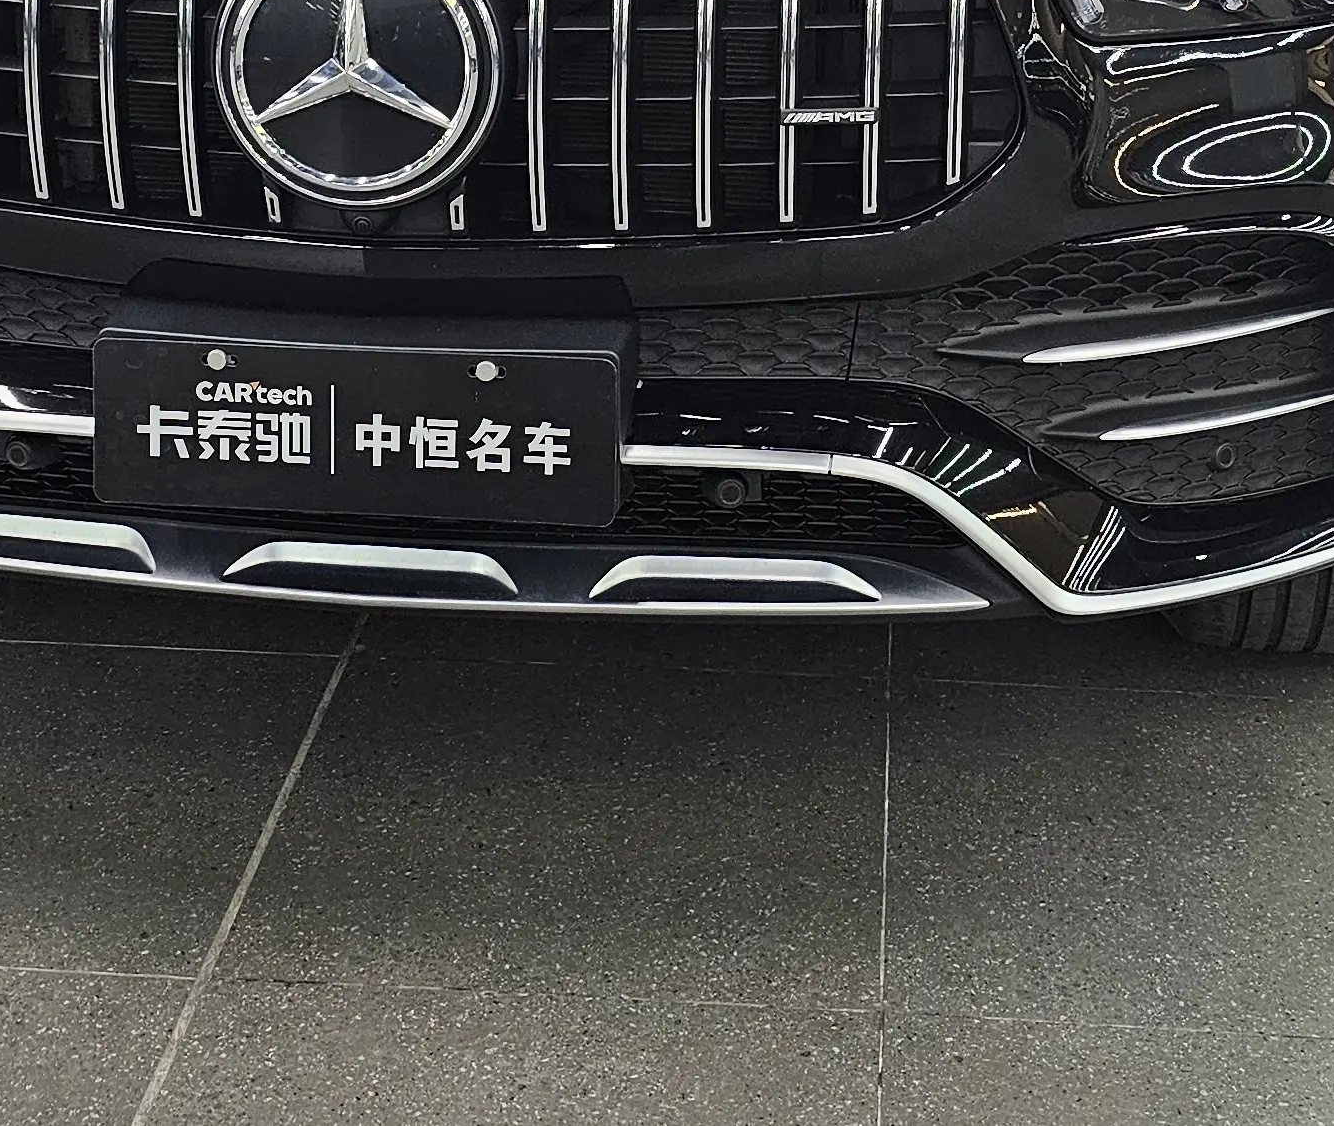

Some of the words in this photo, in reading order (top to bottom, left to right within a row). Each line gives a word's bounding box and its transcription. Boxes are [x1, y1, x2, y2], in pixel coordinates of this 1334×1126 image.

[807, 111, 875, 123] AMG
[195, 380, 313, 406] CARtech
[136, 404, 312, 465] 卡泰驰
[355, 414, 572, 476] 中恒名车
